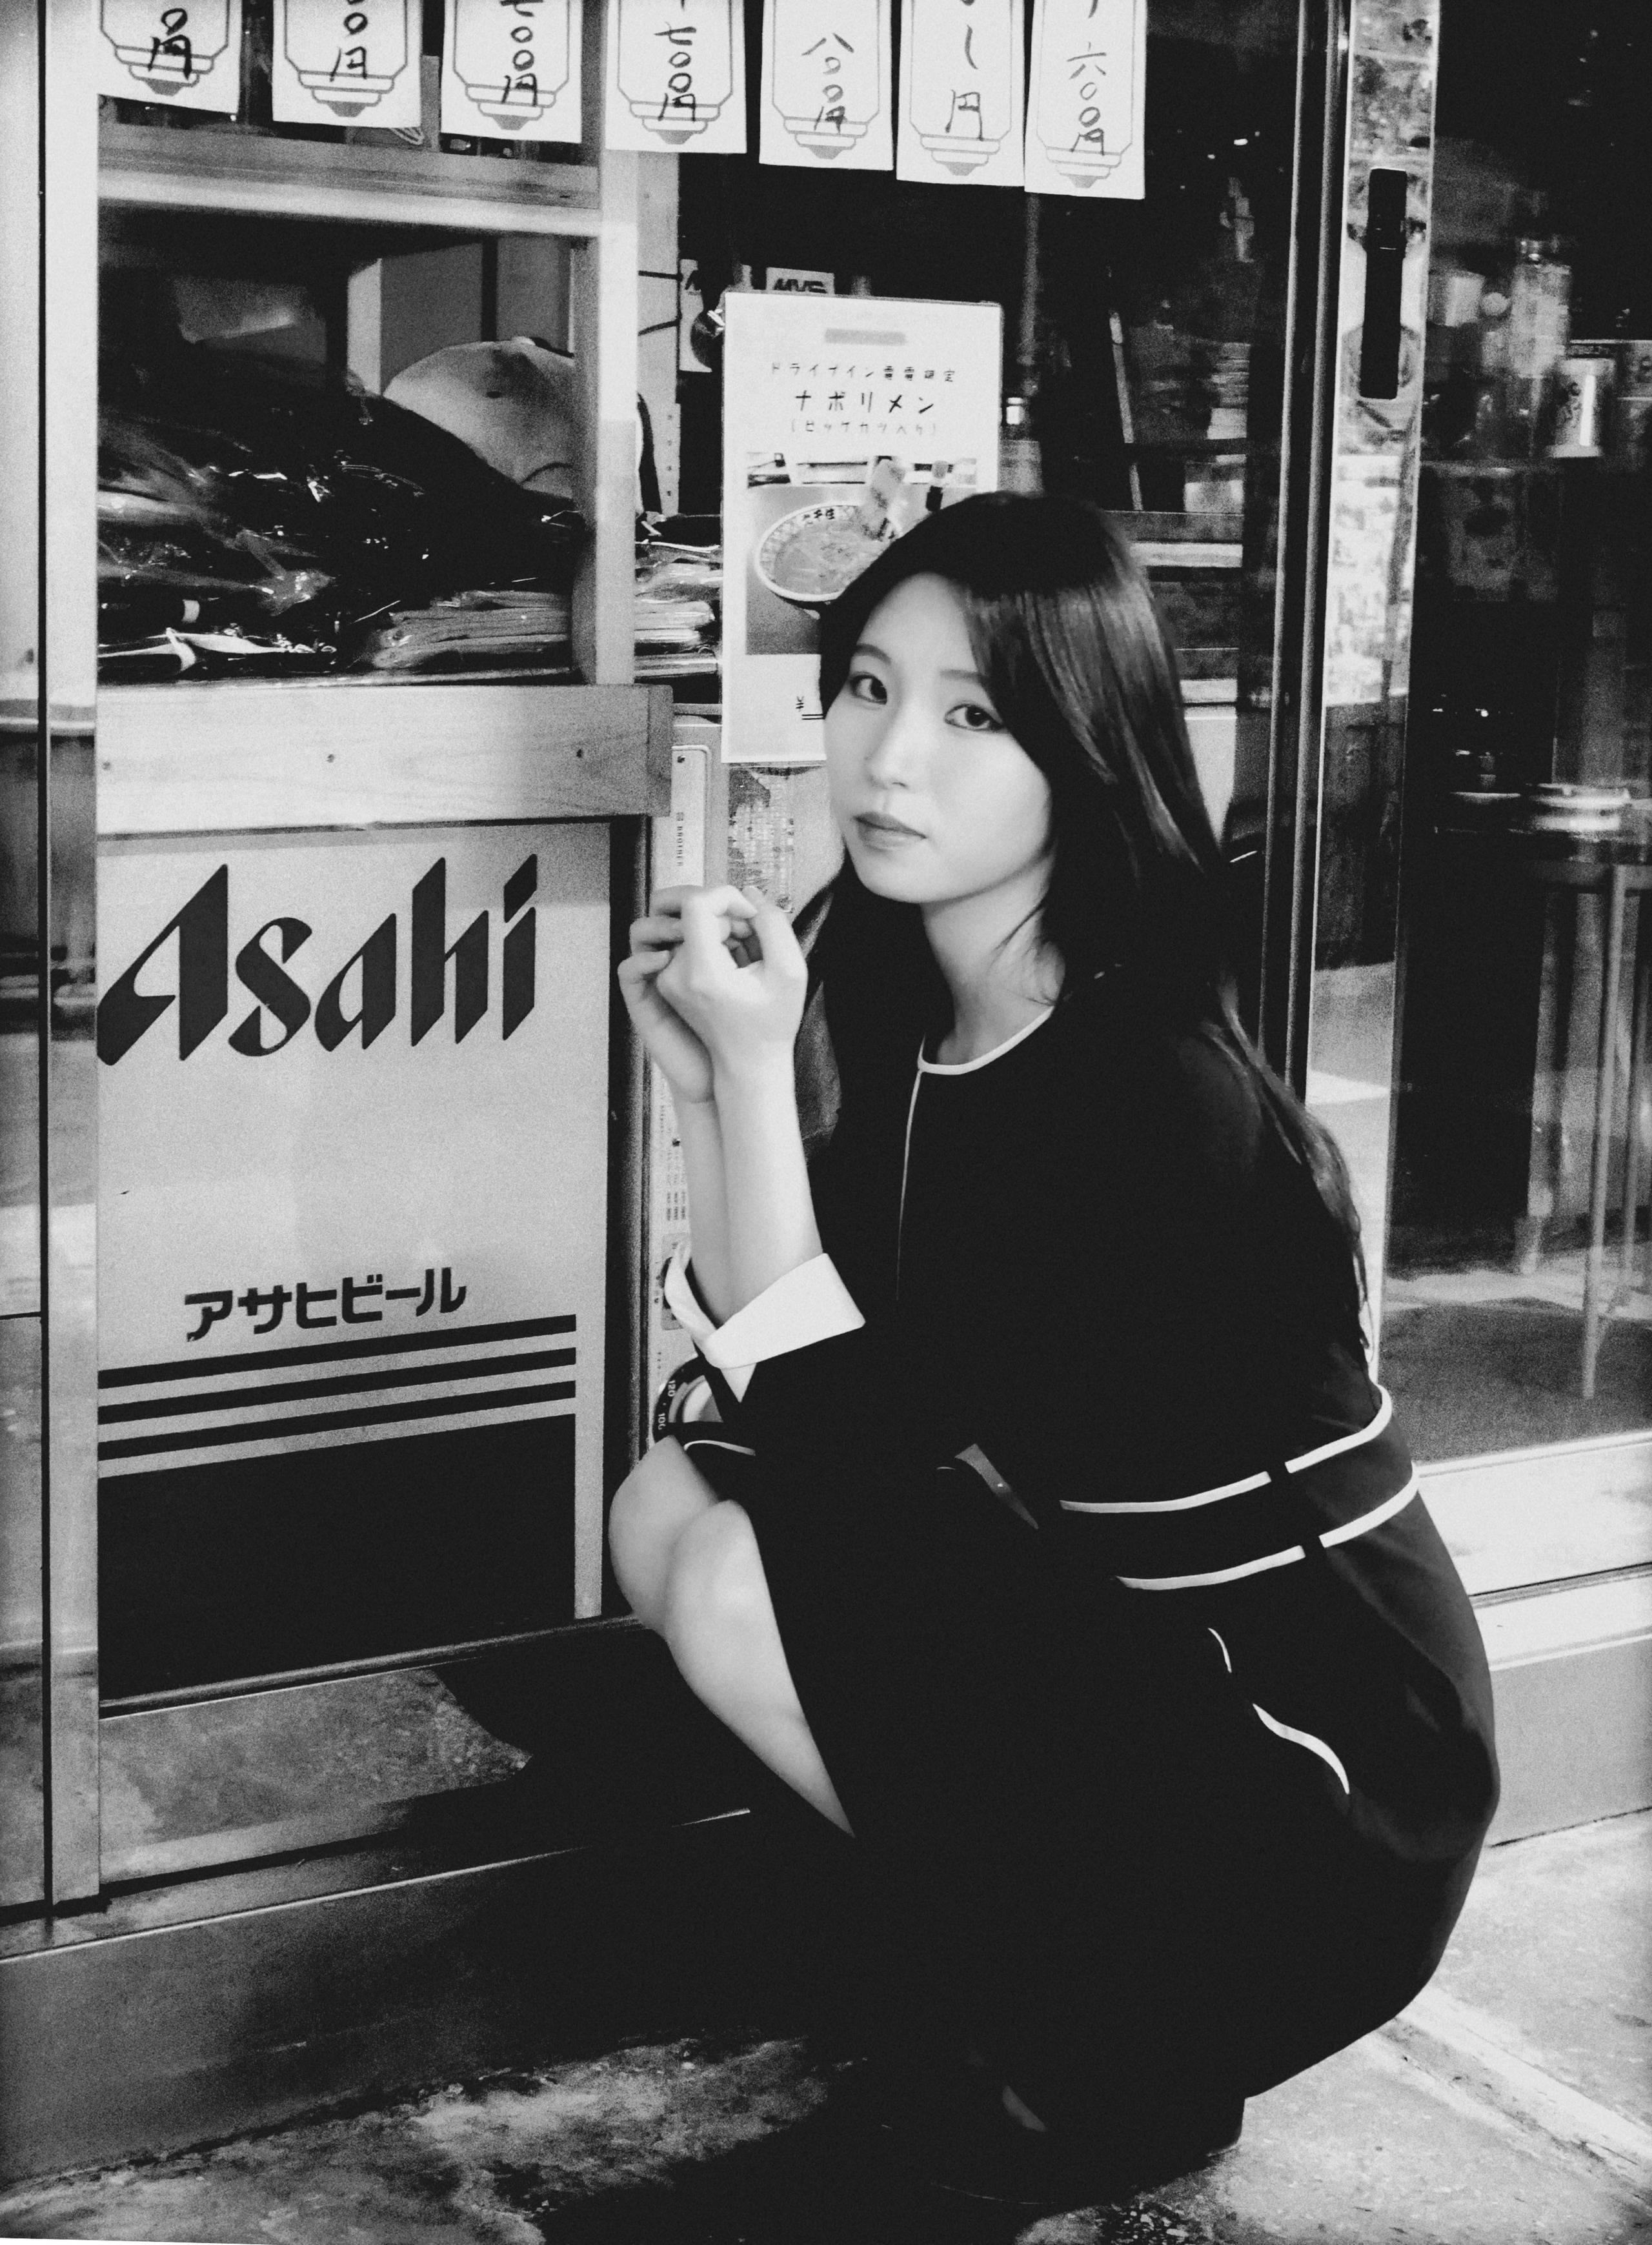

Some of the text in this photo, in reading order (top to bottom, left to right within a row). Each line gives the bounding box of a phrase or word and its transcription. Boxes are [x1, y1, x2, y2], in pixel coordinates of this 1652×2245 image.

[97, 853, 538, 1066] Asahi
[185, 1267, 467, 1342] アサヒビール
